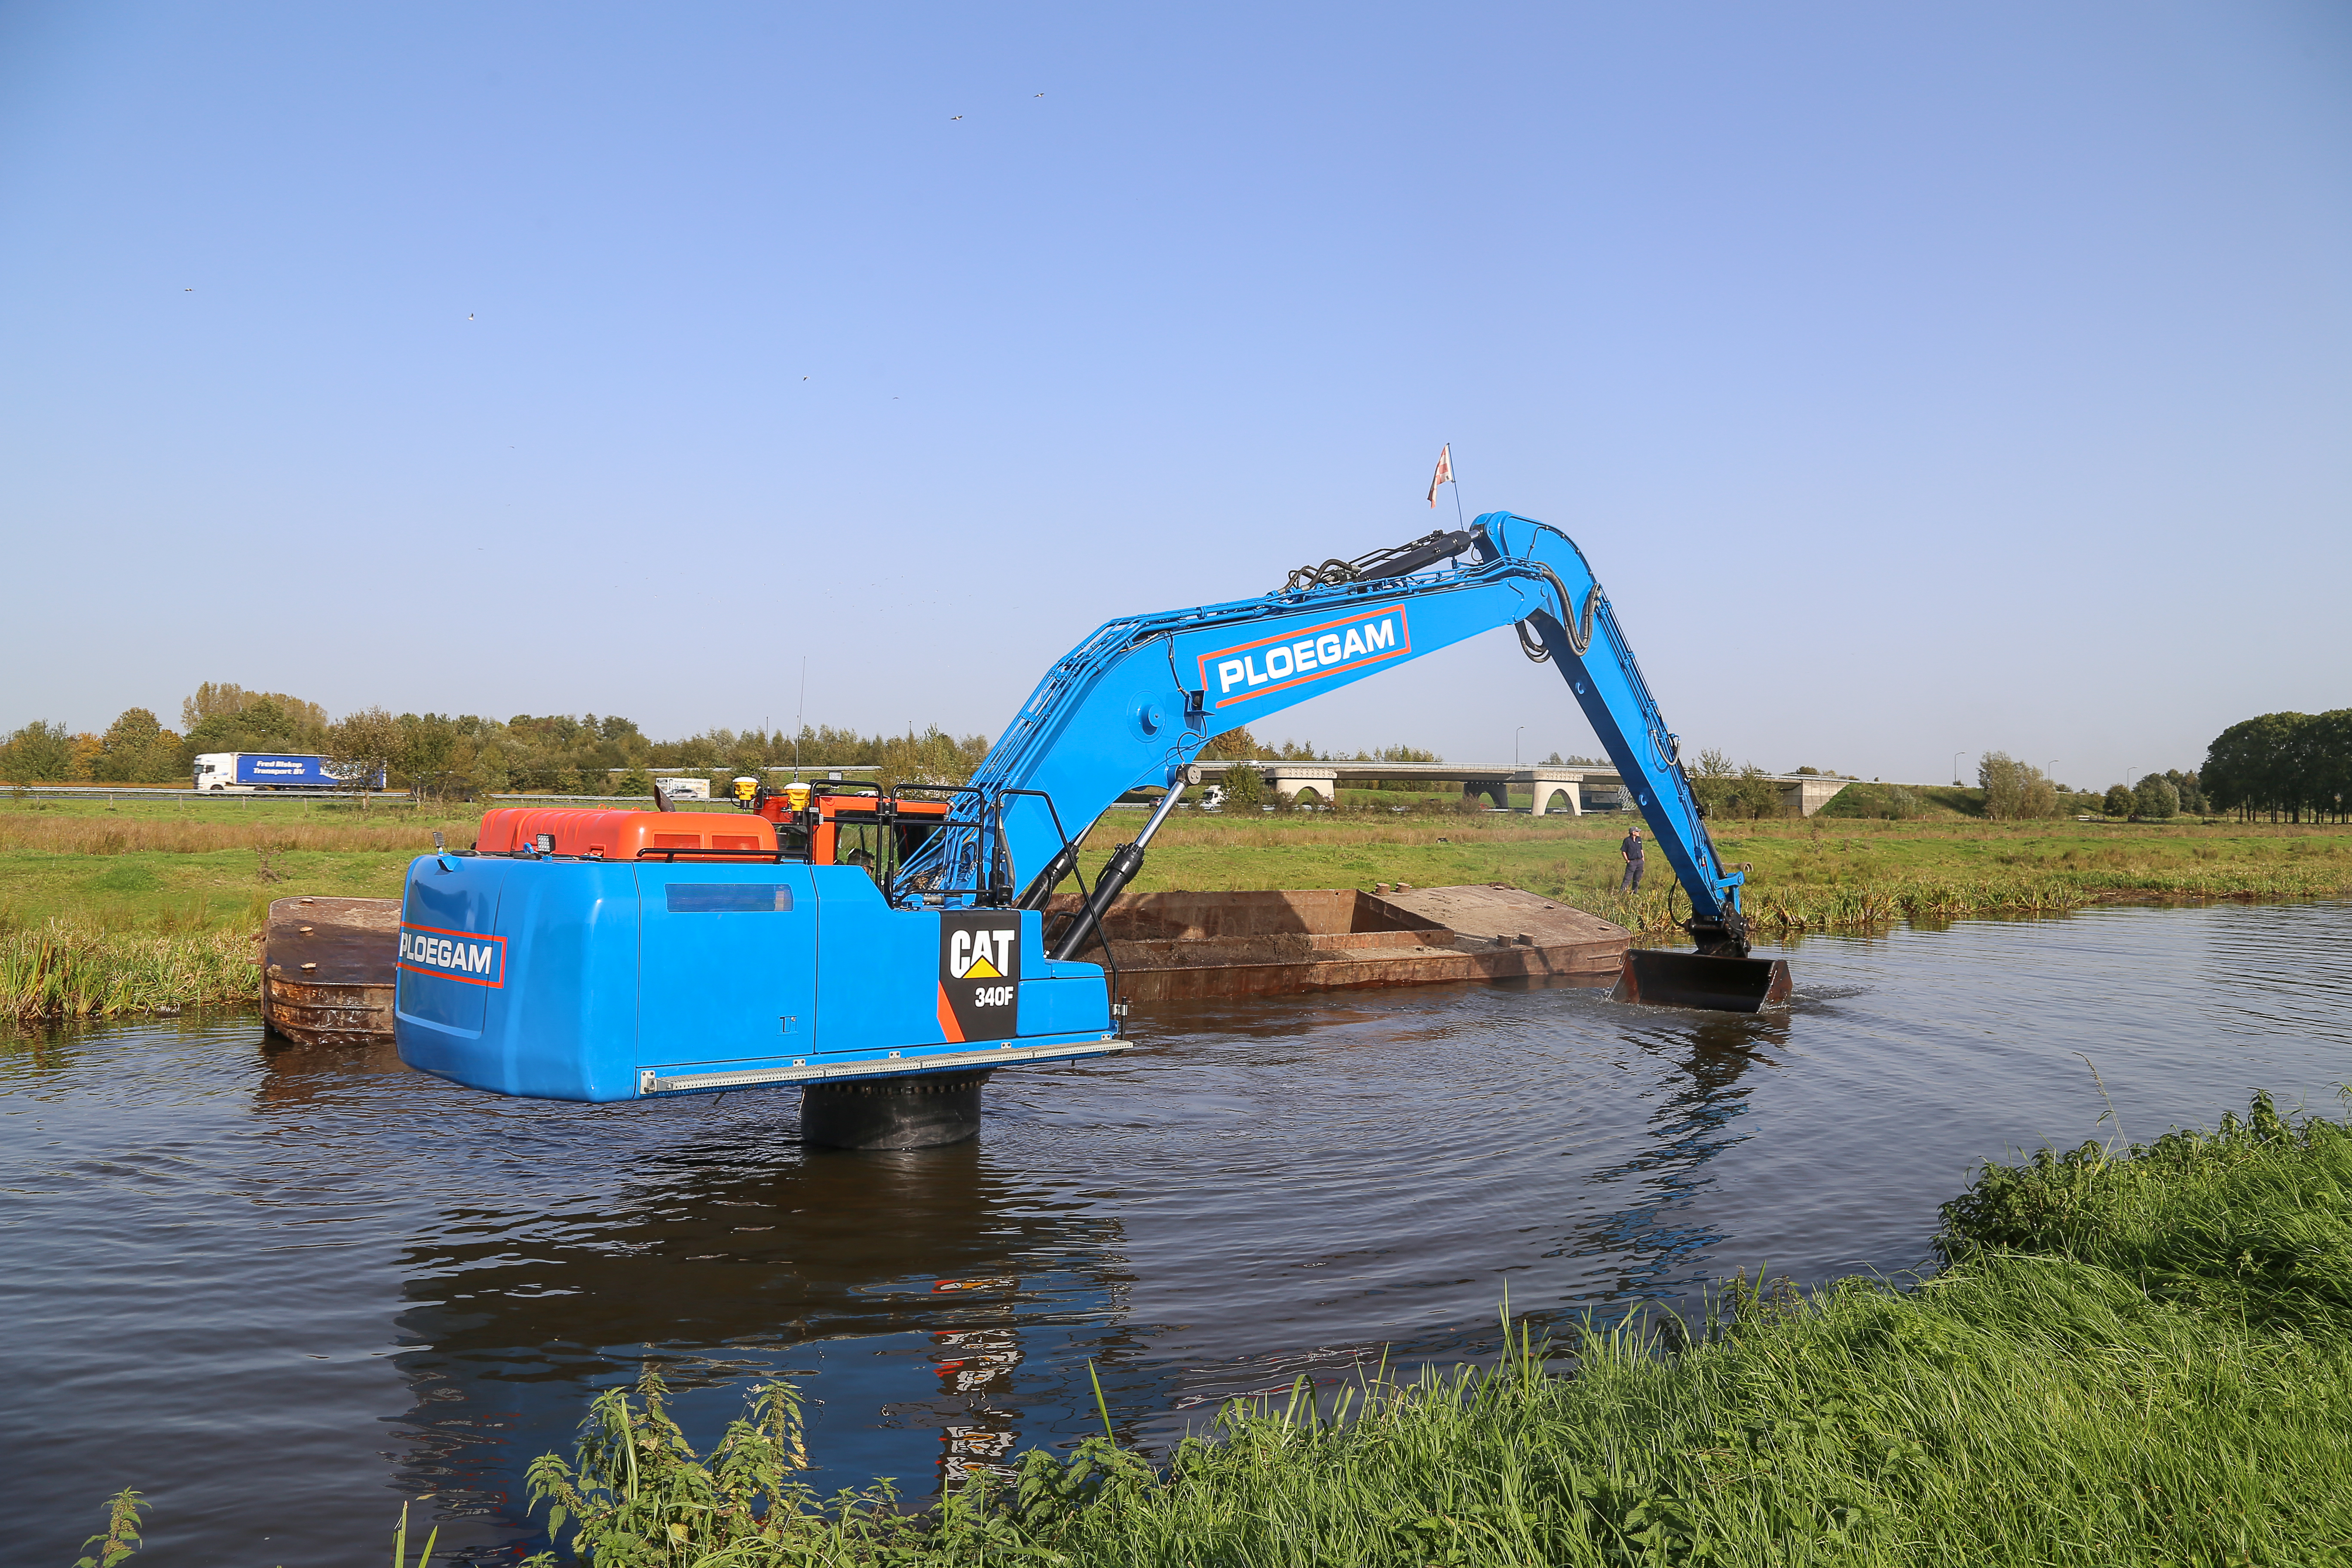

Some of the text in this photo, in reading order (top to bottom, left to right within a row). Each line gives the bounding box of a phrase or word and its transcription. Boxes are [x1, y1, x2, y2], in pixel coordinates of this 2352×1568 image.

[1218, 619, 1395, 693] PLOEGAM
[399, 932, 493, 974] PLOEGAM
[950, 929, 1015, 979] CAT
[975, 986, 1014, 1007] 340F
